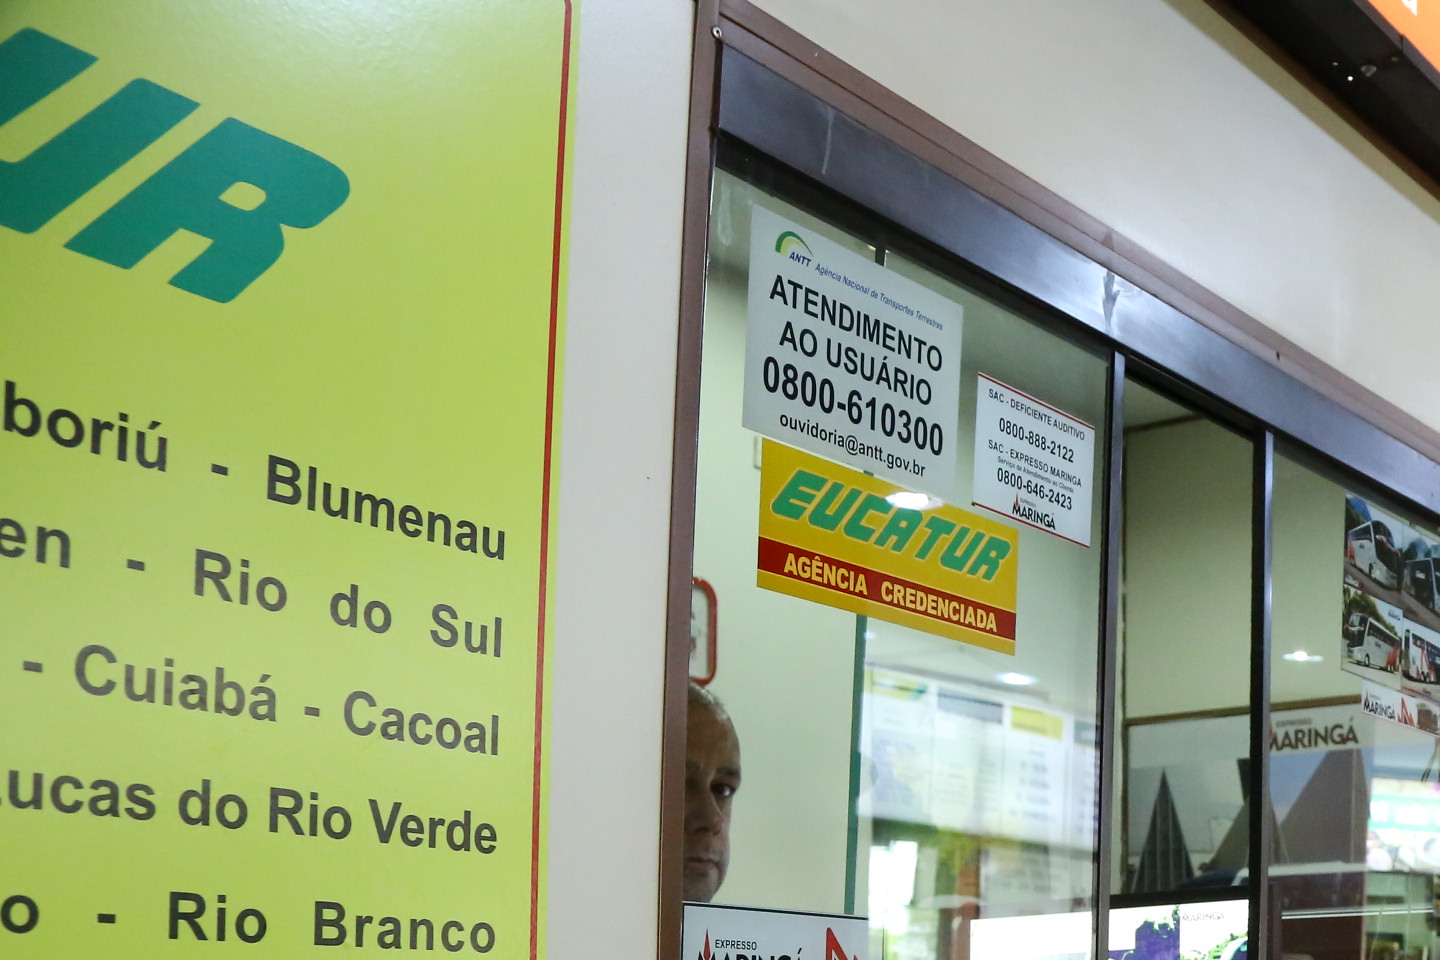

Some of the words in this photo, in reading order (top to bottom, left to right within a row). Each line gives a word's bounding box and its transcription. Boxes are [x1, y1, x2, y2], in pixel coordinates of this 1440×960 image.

[769, 274, 943, 372] ATENDIMENTO
[789, 252, 812, 268] ANTT
[815, 263, 841, 283] Agência
[843, 276, 870, 296] Nacional
[870, 289, 879, 300] de
[880, 293, 914, 317] Transportes
[915, 311, 943, 331] Terrestres
[779, 320, 818, 358] AO
[826, 337, 932, 406] USUÁRIO
[763, 356, 943, 456] 0800-610300
[779, 414, 926, 477] ouvidoria@antt.gov.br
[988, 388, 1005, 404] SAC
[1010, 398, 1052, 426] DEFICIENTE
[1053, 419, 1085, 441] AUDITIVO
[999, 417, 1074, 464] 0800-888-2122
[3, 380, 167, 472] boriú
[266, 454, 505, 561] Blumenau
[988, 439, 1004, 454] SAC
[1010, 448, 1049, 473] EXPRESSO
[997, 467, 1073, 511] 0800-646-2423
[771, 468, 1012, 583] EUCATUR
[195, 548, 288, 612] Rio
[329, 584, 393, 635] do
[429, 603, 502, 658] Sul
[784, 552, 868, 596] AGÊNCIA
[881, 580, 998, 633] CREDENCIADA
[74, 643, 277, 722] Cuiabá
[343, 690, 500, 756] Cacoal
[0, 768, 156, 821] ucas
[178, 779, 249, 830] do
[268, 787, 352, 841] Rio
[369, 799, 498, 855] Verde
[168, 891, 268, 944] Rio
[313, 900, 496, 954] Branco
[715, 939, 757, 951] EXPRESSO
